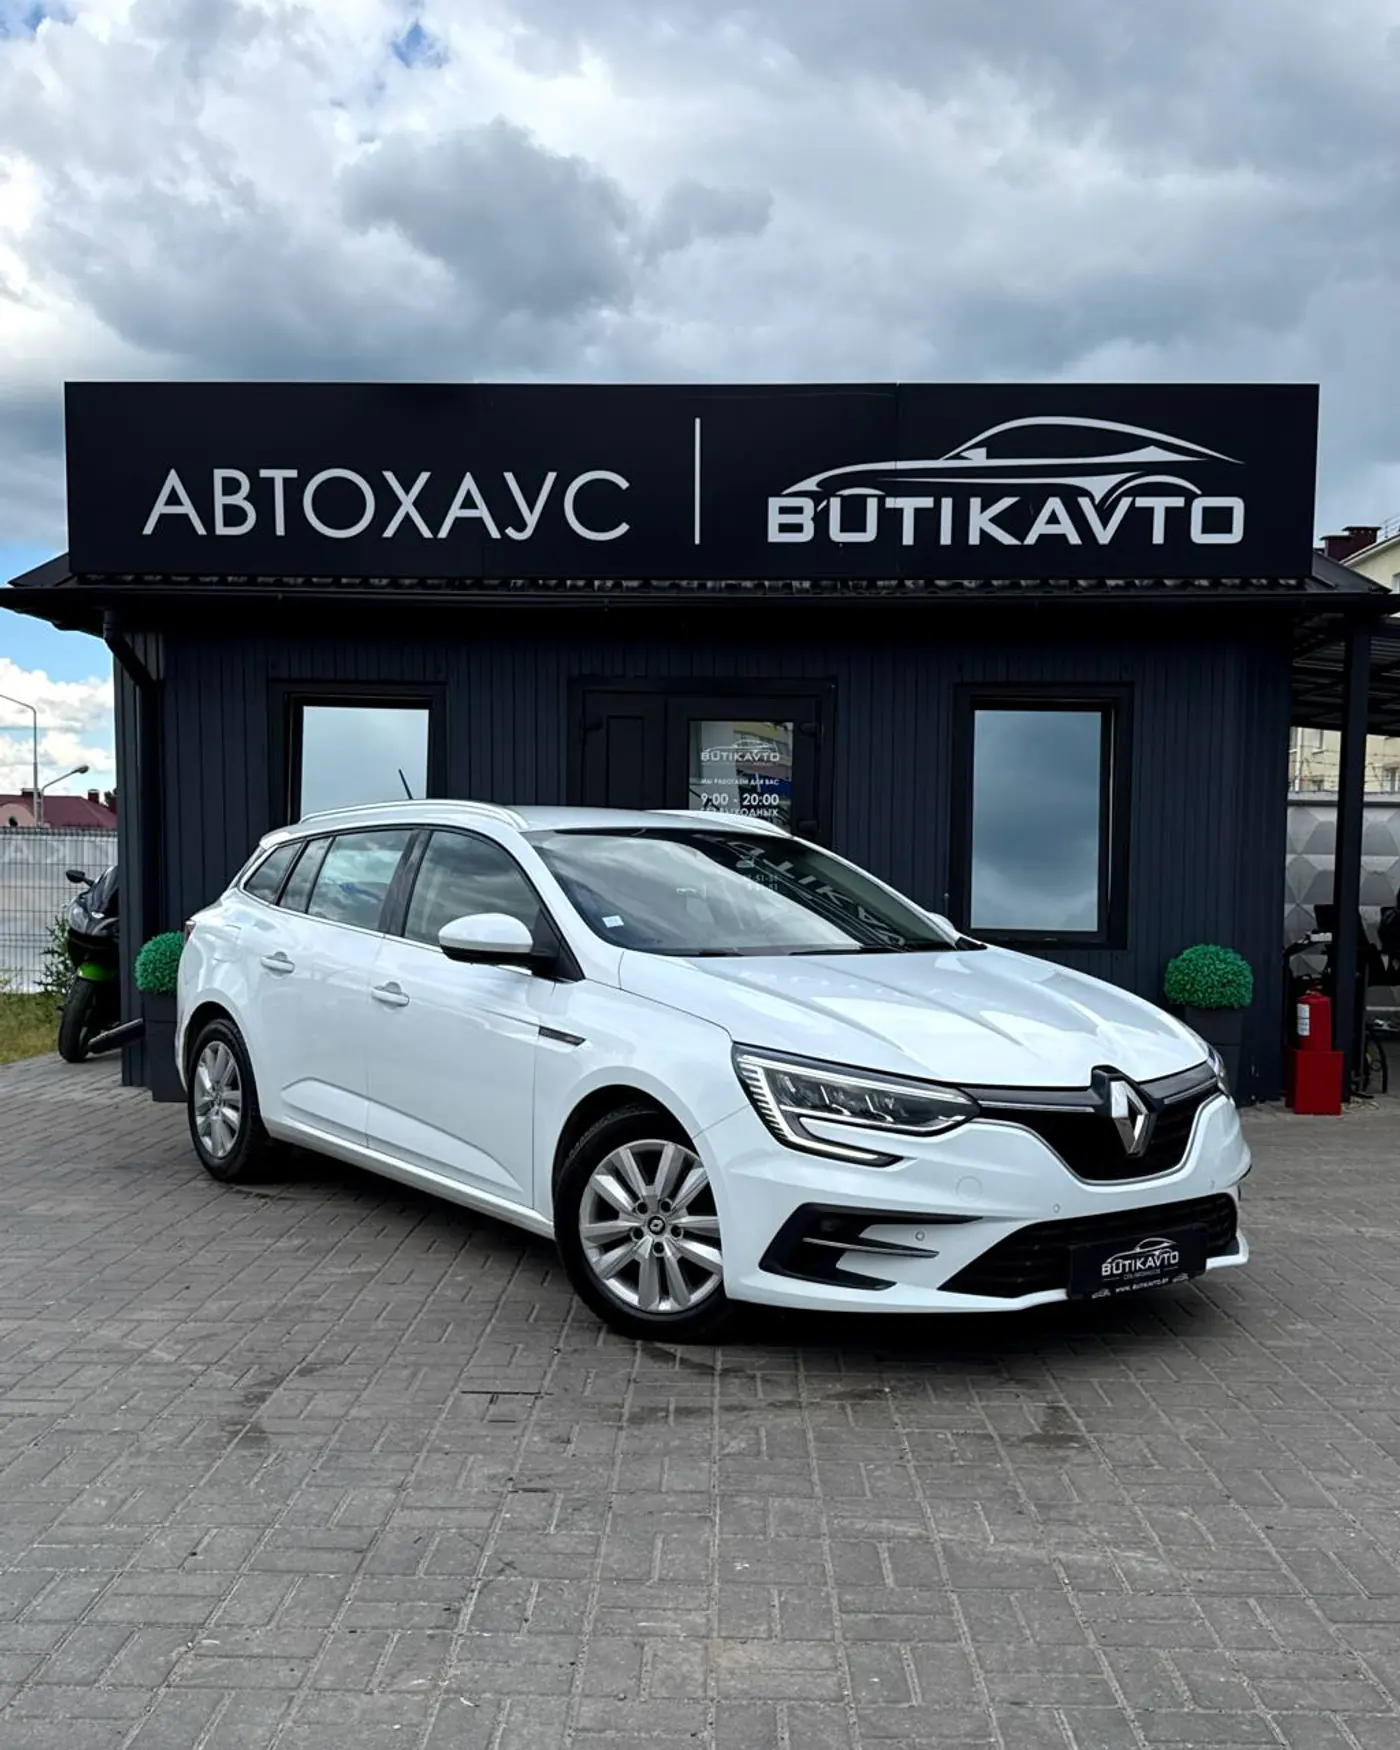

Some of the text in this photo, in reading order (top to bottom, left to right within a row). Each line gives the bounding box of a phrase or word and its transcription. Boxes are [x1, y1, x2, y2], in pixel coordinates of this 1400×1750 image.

[142, 467, 631, 541] АВТОХАУС
[767, 496, 1245, 546] BUTIKAVTO
[701, 751, 780, 761] BUTIKAVTO
[701, 793, 729, 805] 9:00
[743, 794, 780, 806] 20:00
[1101, 1251, 1179, 1276] BUTIKAVTO
